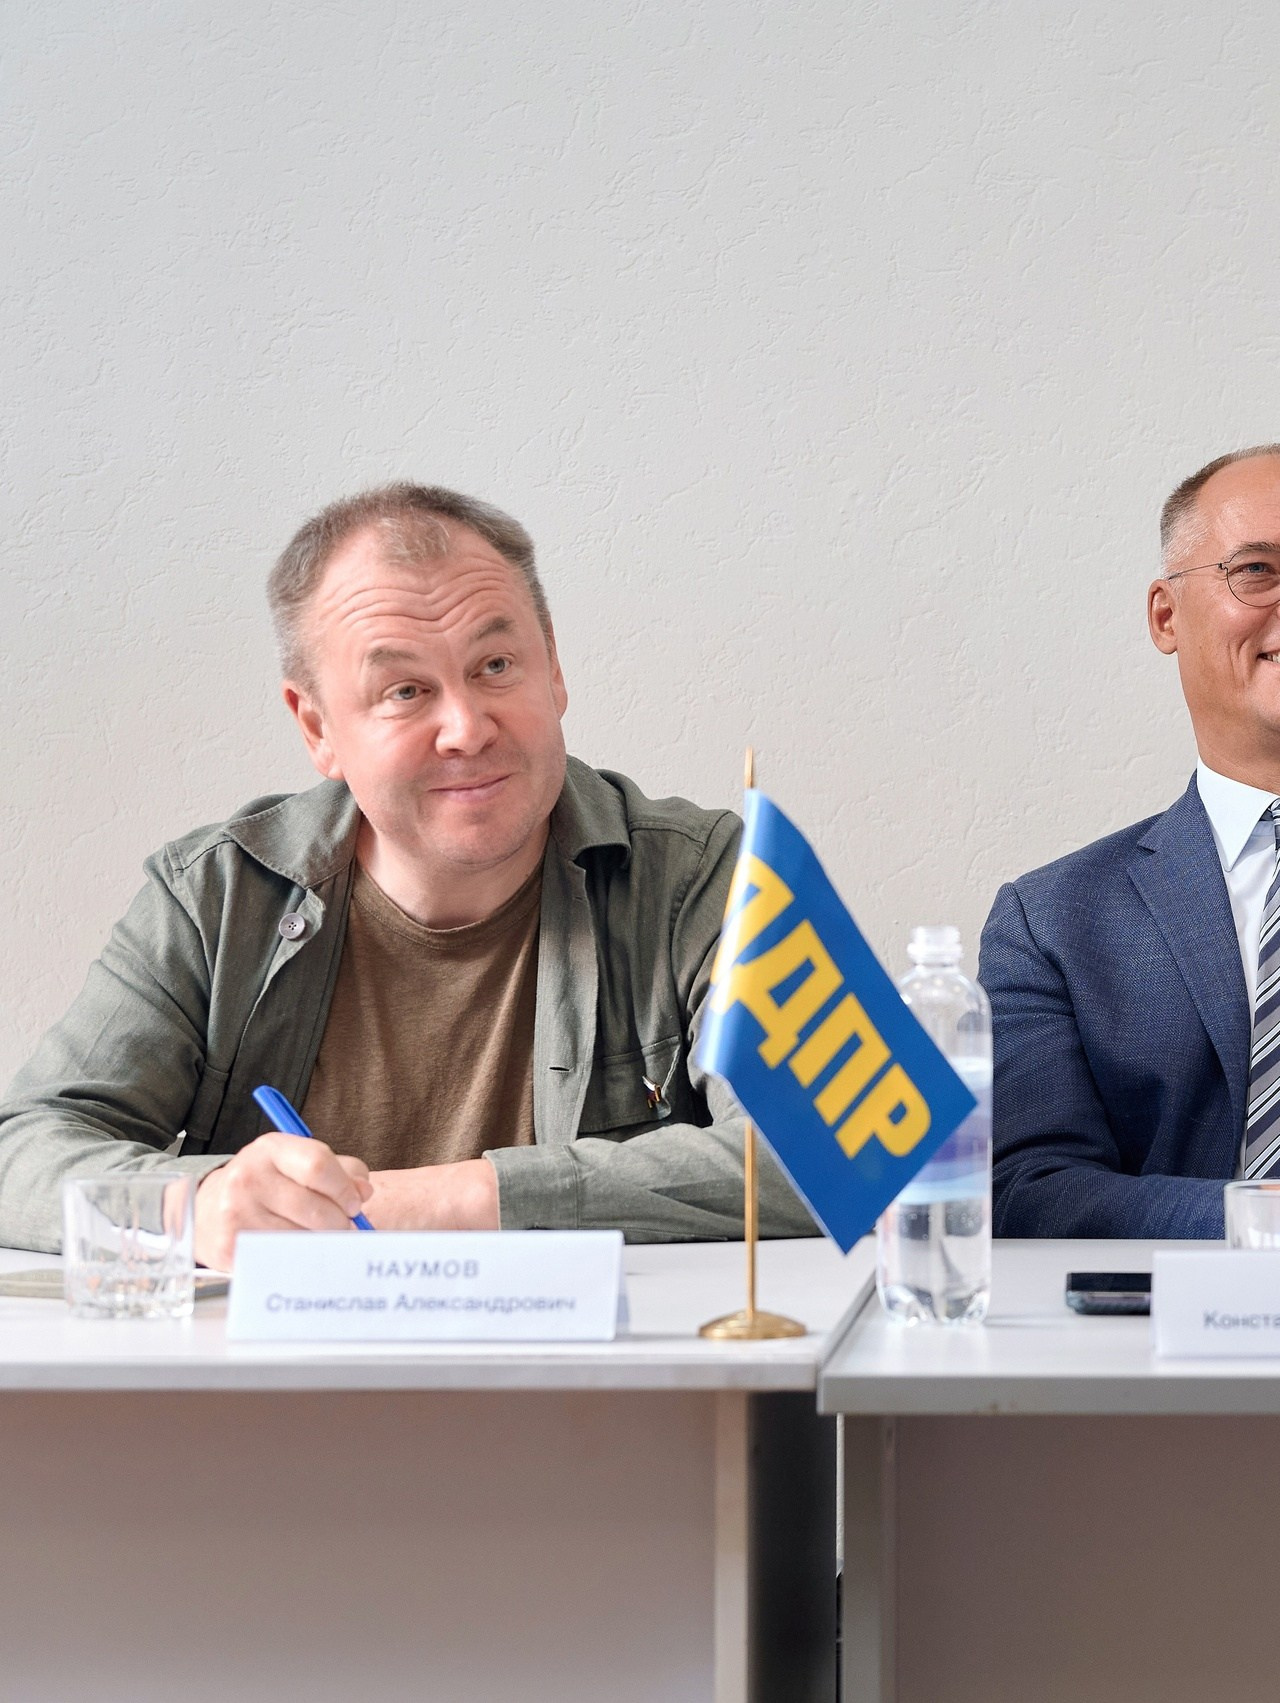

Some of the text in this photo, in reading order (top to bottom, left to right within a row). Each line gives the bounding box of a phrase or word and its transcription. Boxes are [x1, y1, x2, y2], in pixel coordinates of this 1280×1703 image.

[710, 853, 932, 1160] ЛДПР
[366, 1260, 479, 1278] НАУМОВ
[266, 1294, 576, 1314] Станислав Александрович
